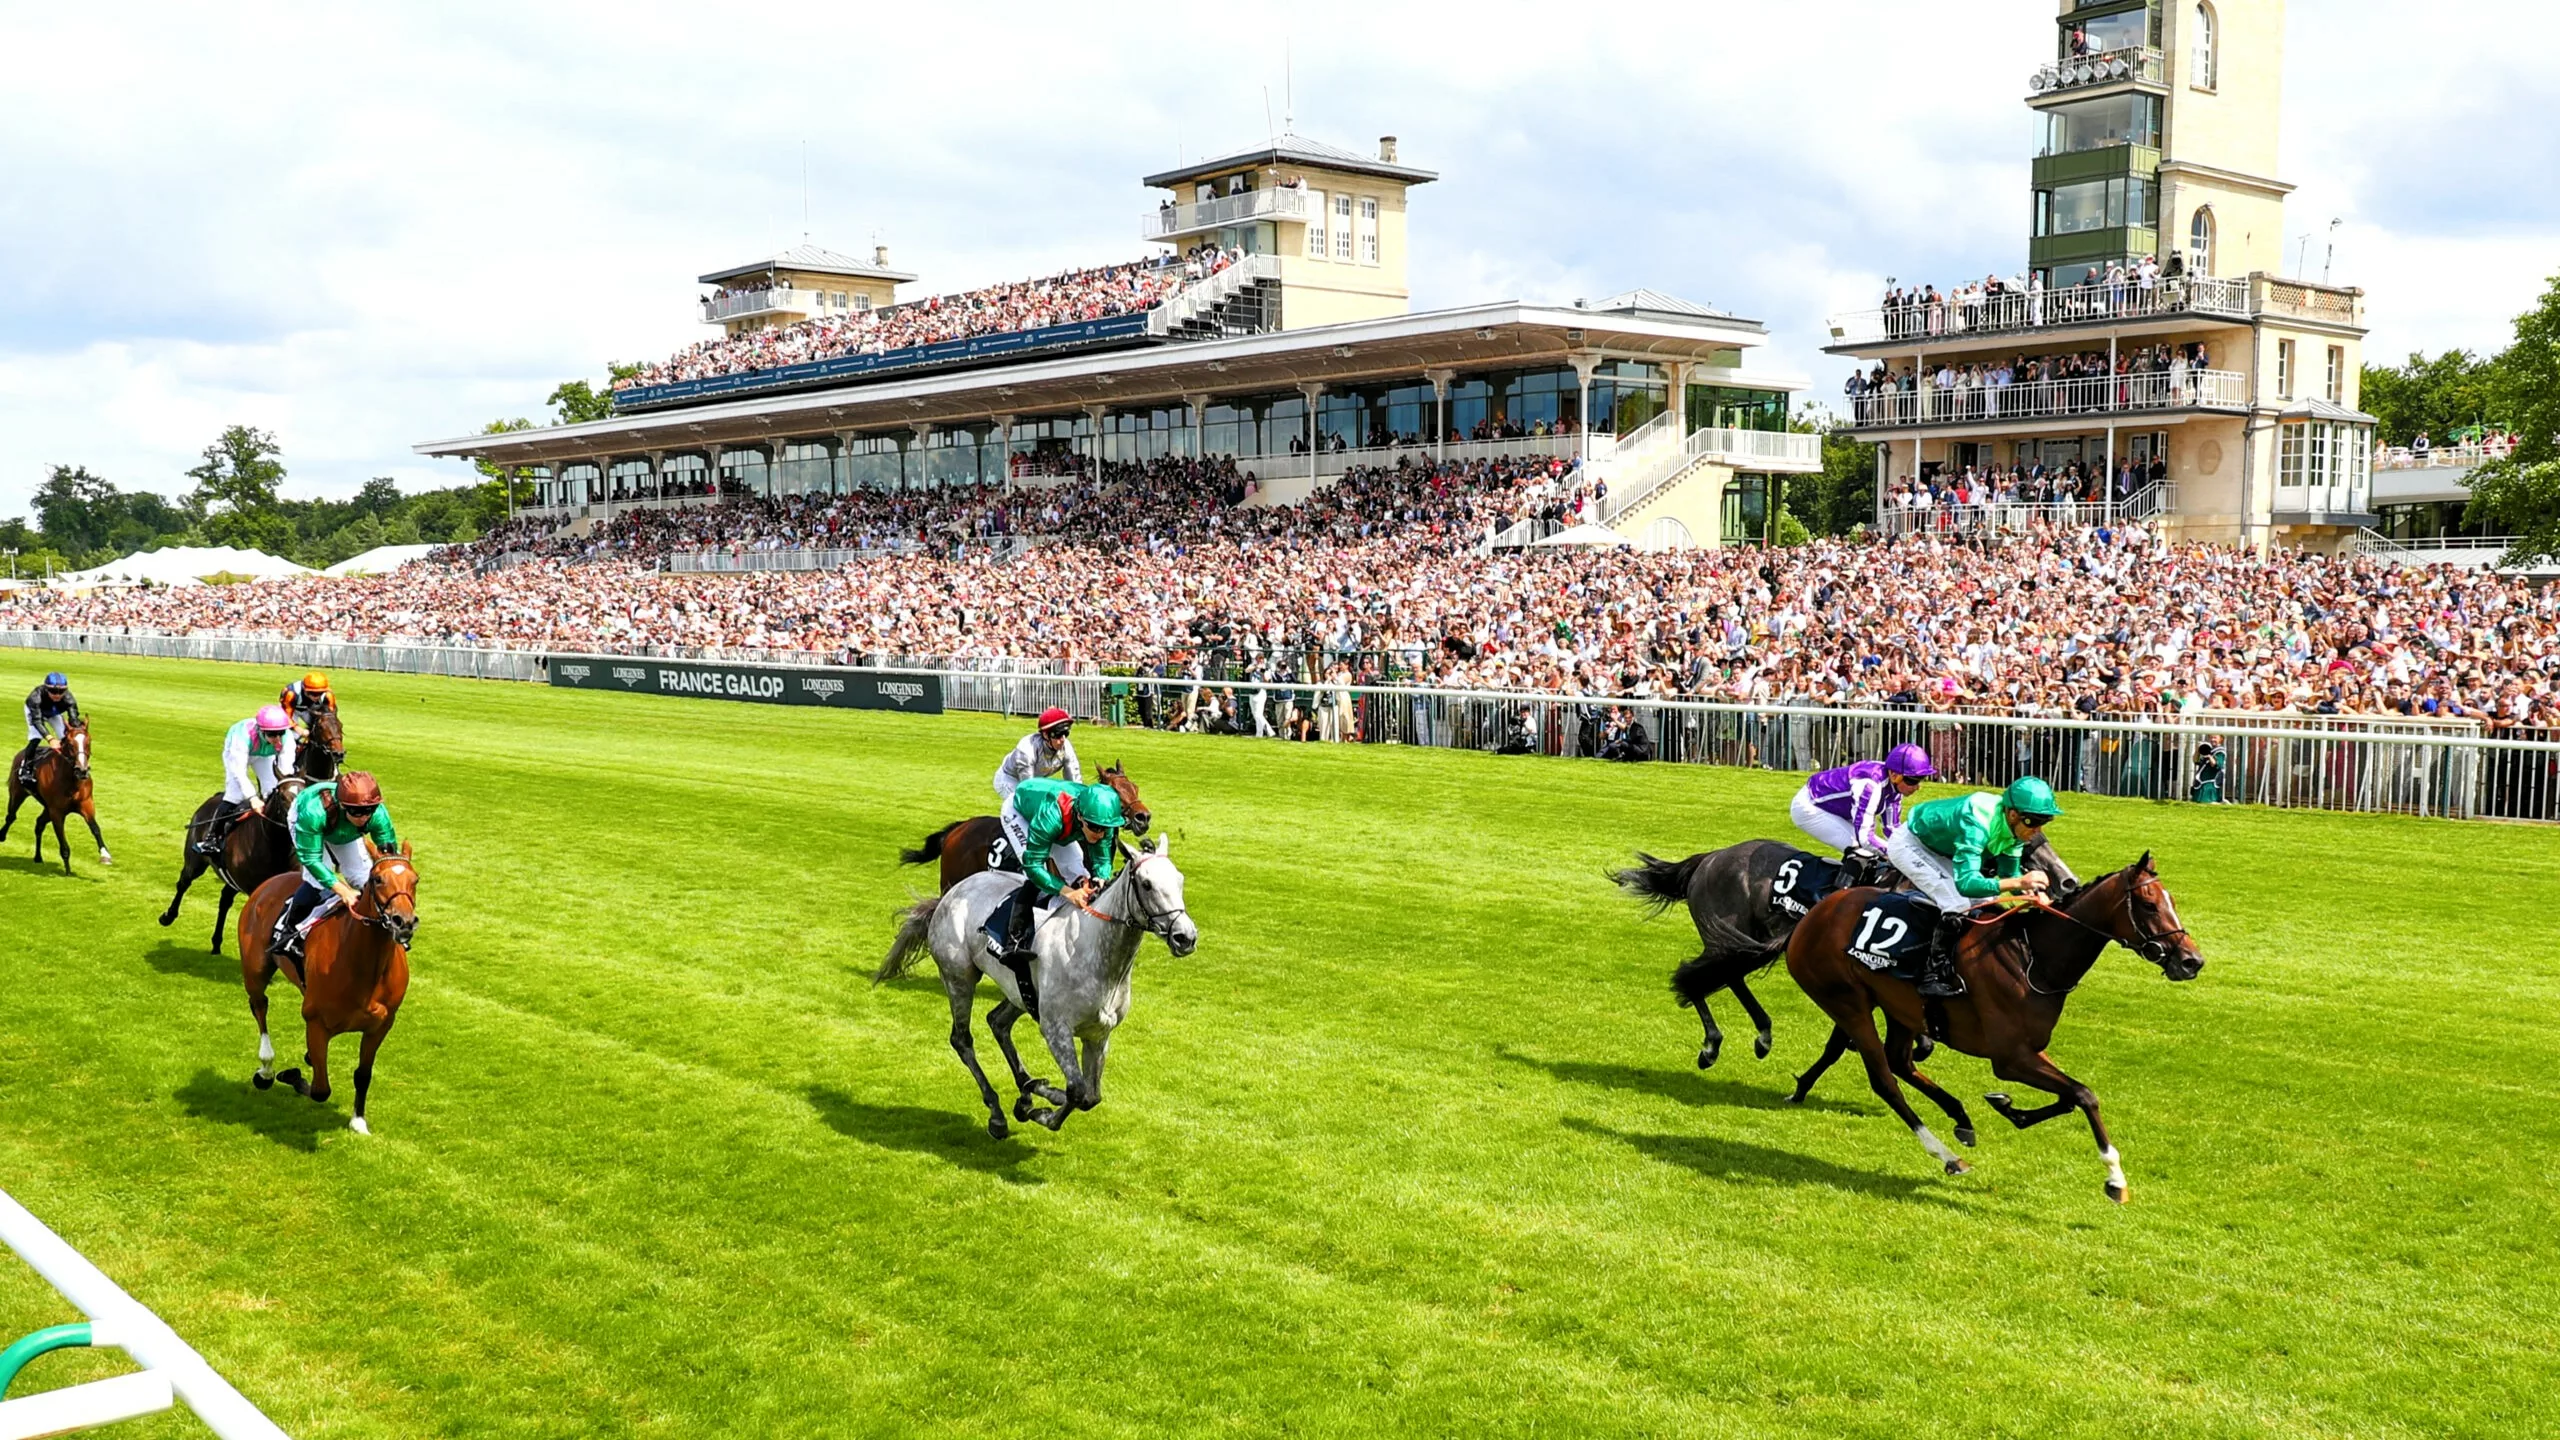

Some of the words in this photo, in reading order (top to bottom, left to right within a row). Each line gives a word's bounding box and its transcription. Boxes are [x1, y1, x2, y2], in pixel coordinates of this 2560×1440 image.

[560, 665, 591, 677] LONGINES
[612, 667, 646, 680] LONGINES
[659, 669, 724, 694] FRANCE
[725, 674, 784, 698] GALOP
[801, 678, 845, 693] LONGINES
[877, 681, 924, 697] LONGINES
[988, 837, 1008, 868] 3
[1773, 859, 1803, 894] 5
[1854, 906, 1908, 959] 12
